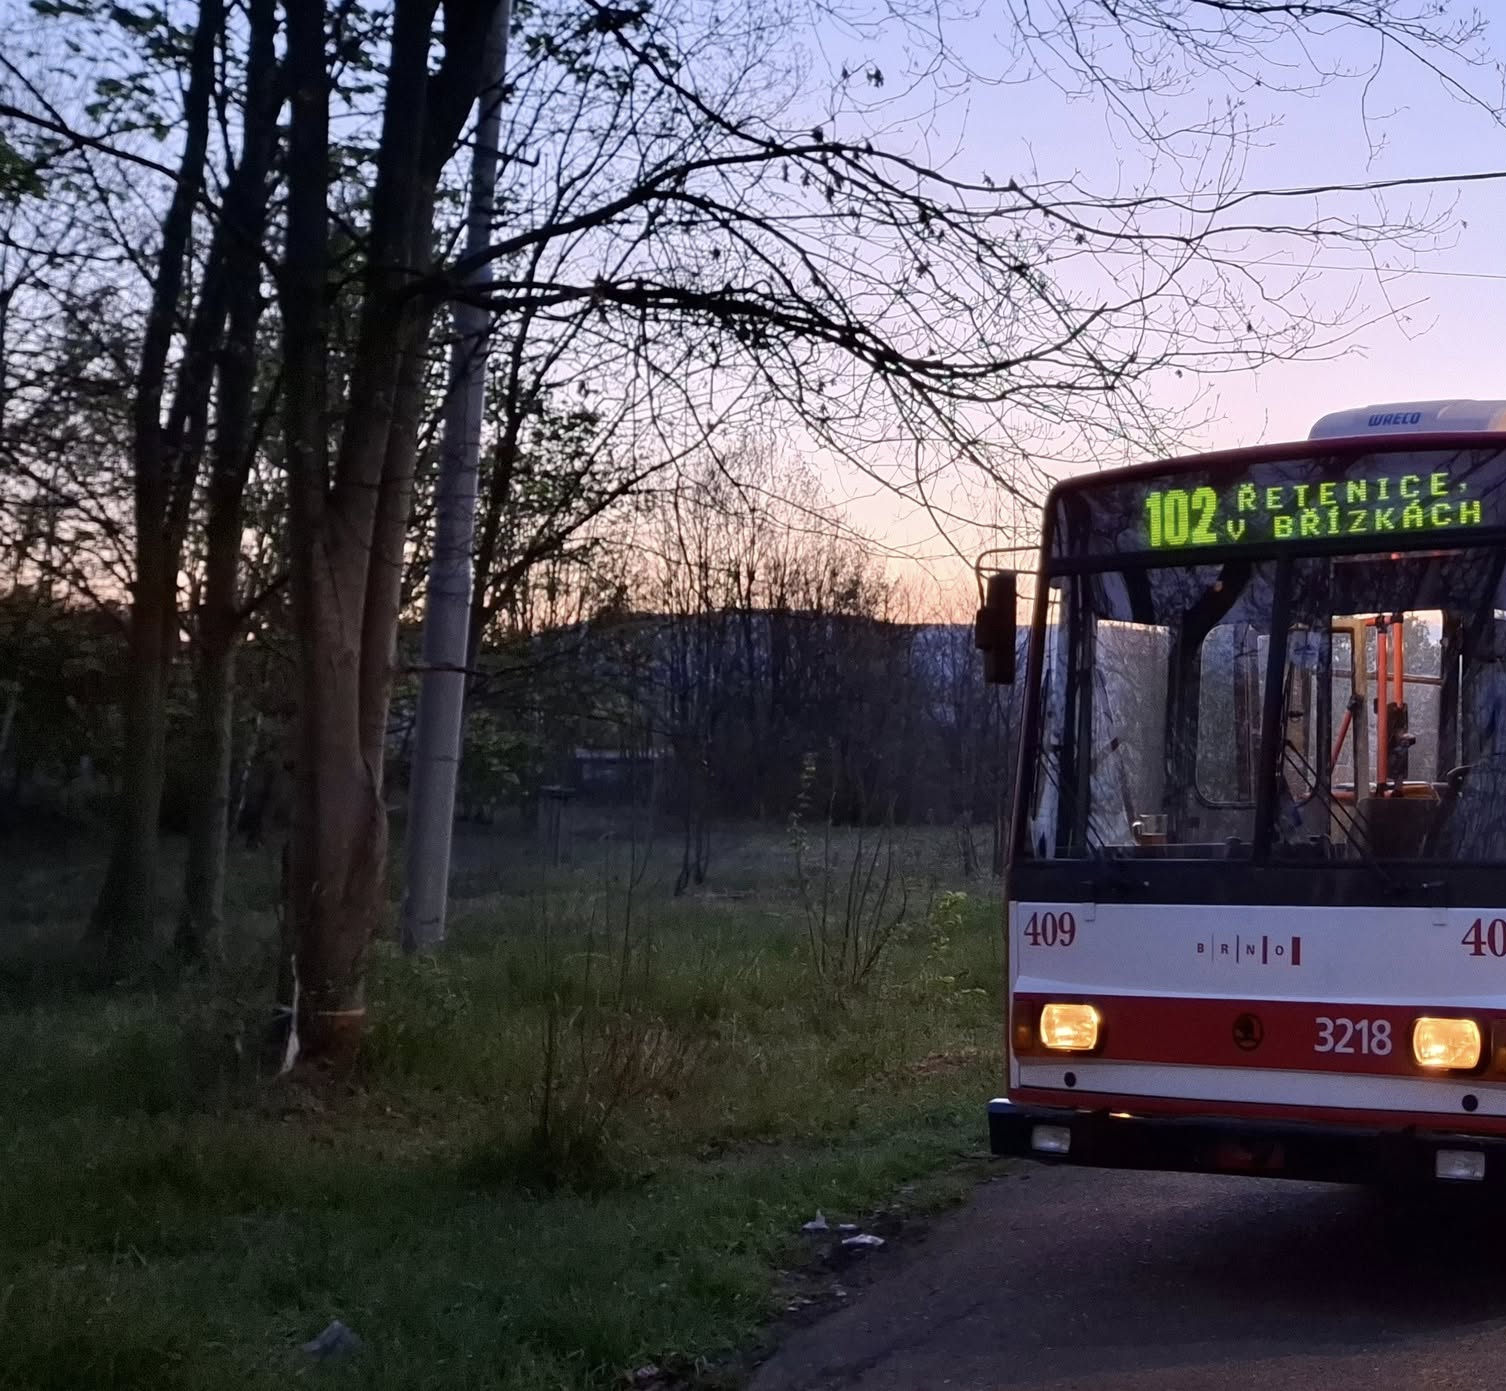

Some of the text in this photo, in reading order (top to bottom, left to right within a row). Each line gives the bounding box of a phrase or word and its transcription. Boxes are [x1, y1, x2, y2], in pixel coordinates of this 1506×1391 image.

[1368, 412, 1422, 427] WAECO
[1238, 473, 1468, 511] ŘETENICE,
[1146, 487, 1217, 546] 102
[1273, 499, 1481, 538] BŘÍZKÁCH
[1023, 912, 1076, 947] 409
[1314, 1017, 1393, 1056] 3218
